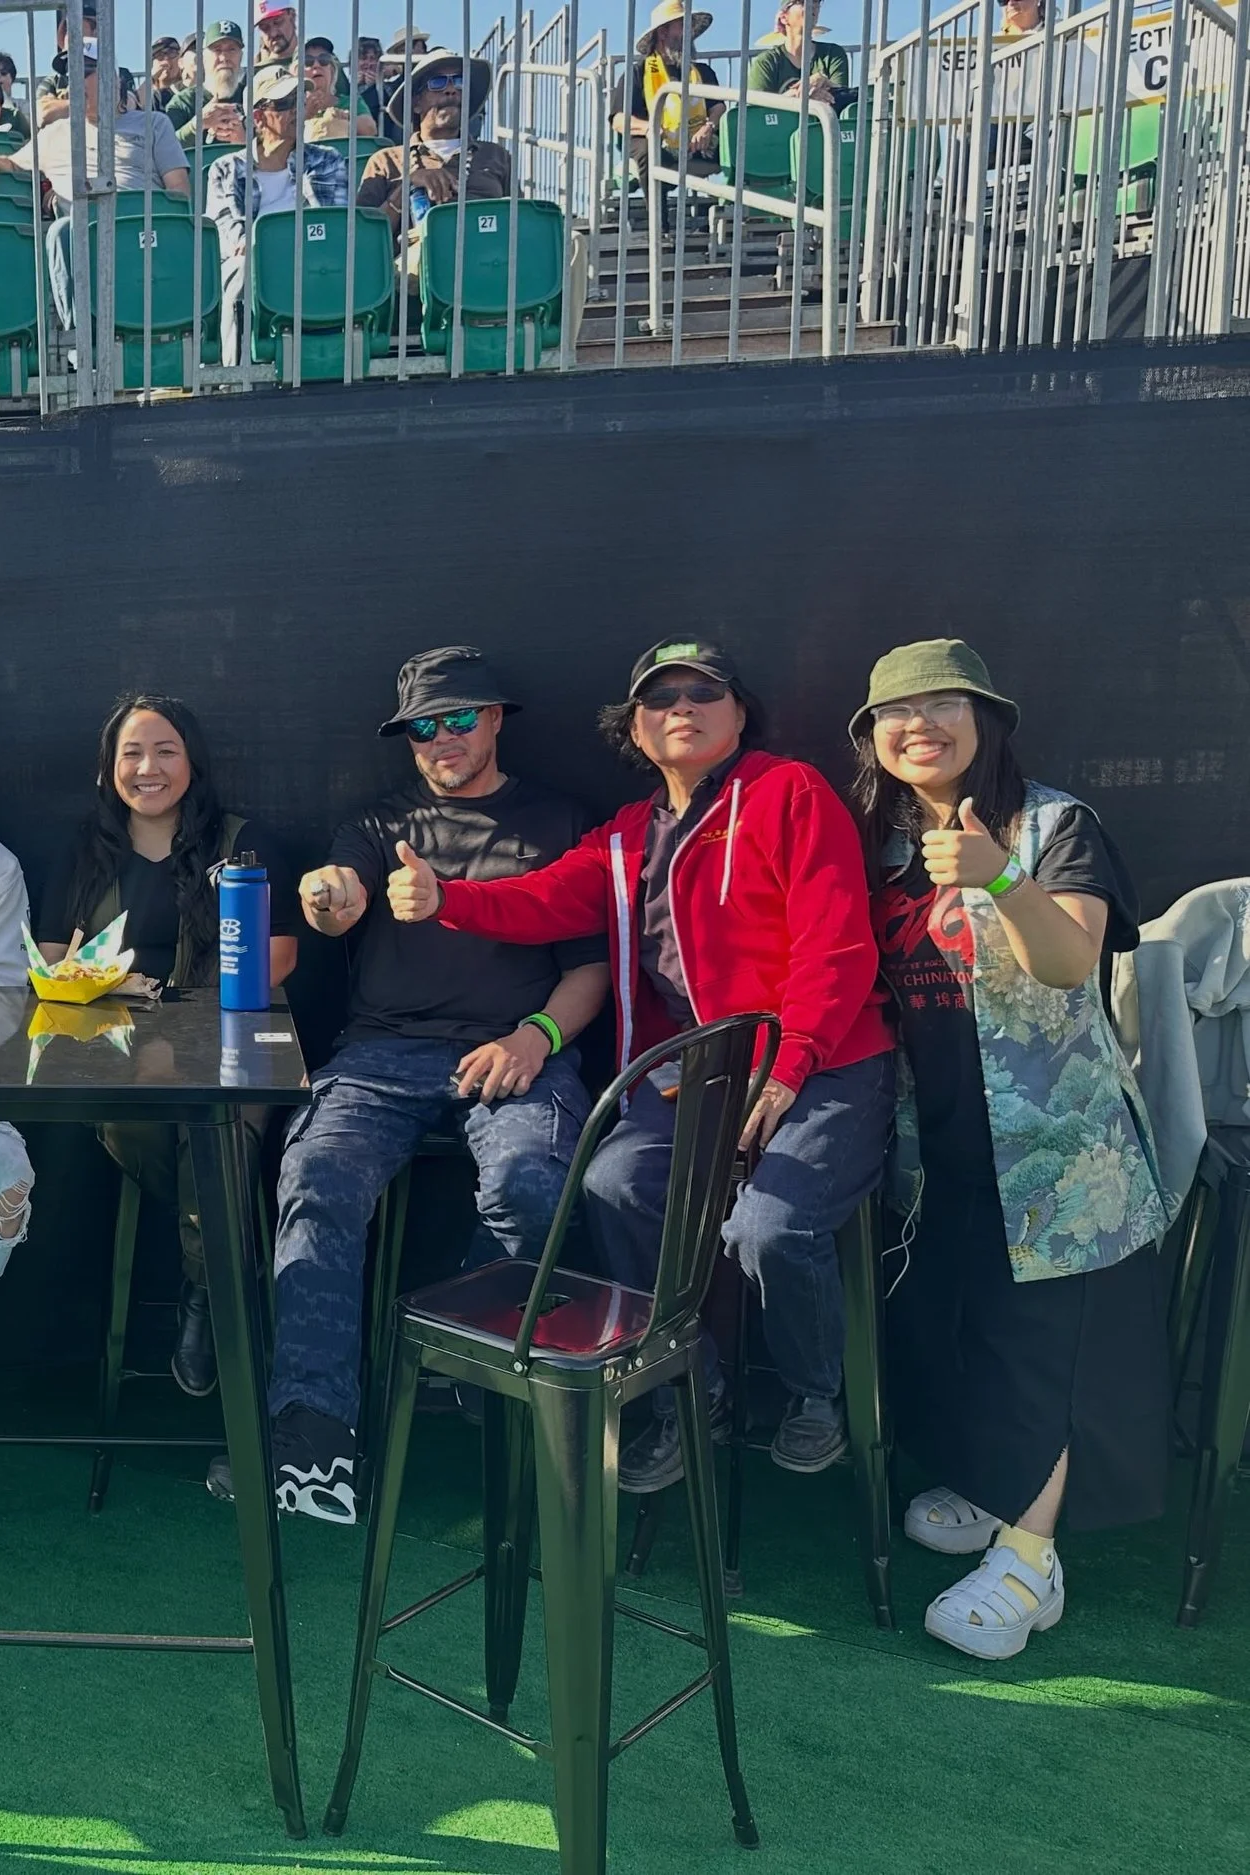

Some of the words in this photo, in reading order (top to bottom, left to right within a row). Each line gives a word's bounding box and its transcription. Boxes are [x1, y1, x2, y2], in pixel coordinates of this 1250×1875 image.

[1144, 55, 1169, 91] C
[480, 217, 495, 228] 27
[309, 225, 324, 237] 26
